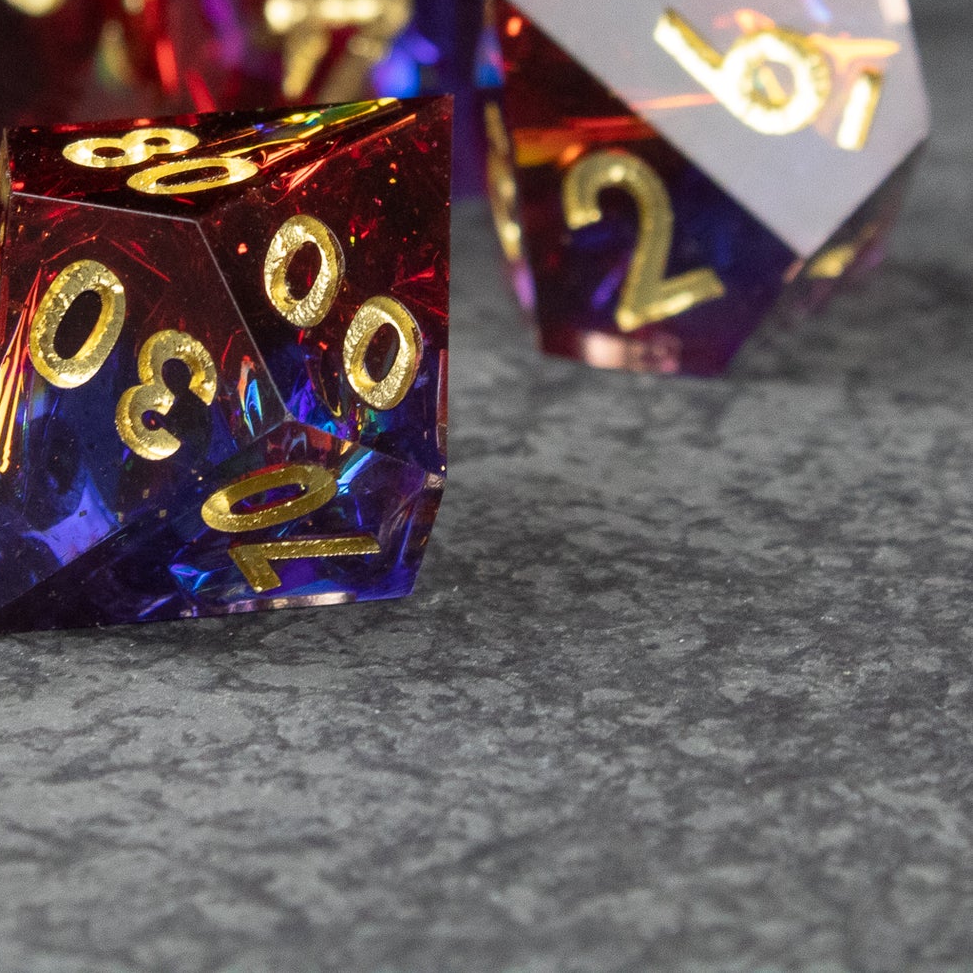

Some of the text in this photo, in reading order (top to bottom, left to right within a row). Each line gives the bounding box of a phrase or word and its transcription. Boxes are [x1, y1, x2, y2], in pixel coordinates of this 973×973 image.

[62, 128, 258, 195] 80
[563, 151, 725, 331] 2
[30, 258, 218, 461] 30
[264, 214, 424, 410] 00
